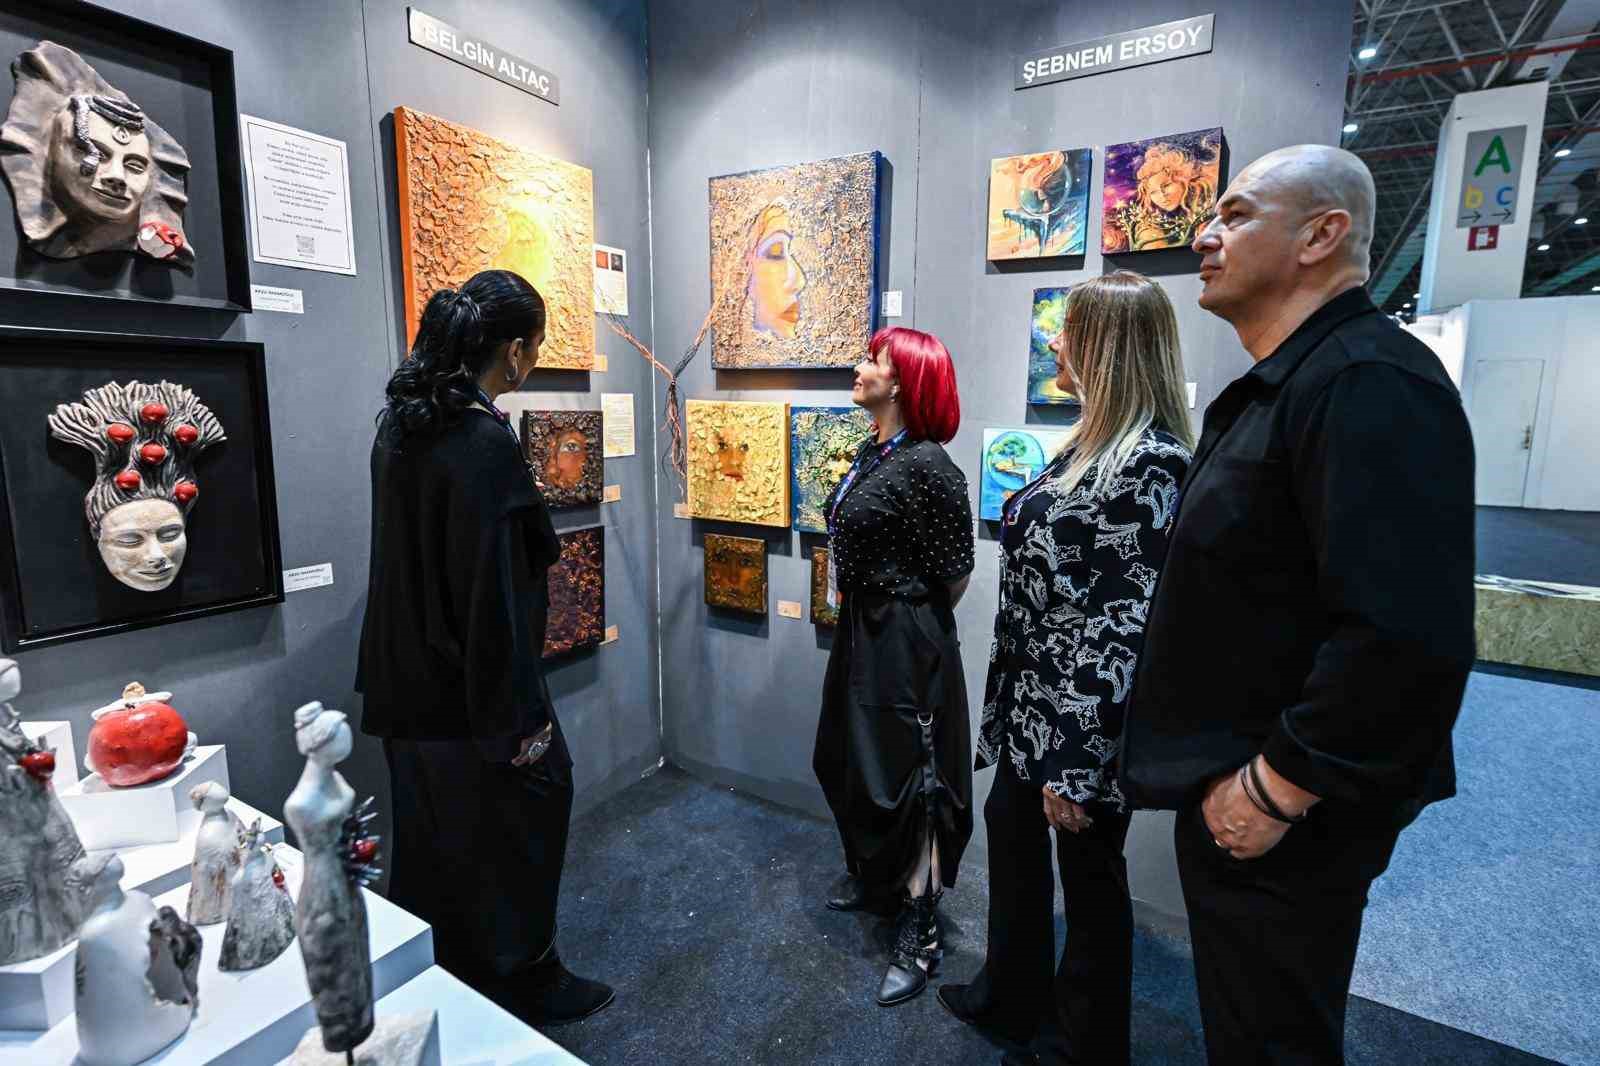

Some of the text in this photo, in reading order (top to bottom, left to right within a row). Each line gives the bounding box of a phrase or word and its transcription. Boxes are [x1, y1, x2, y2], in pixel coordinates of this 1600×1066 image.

[424, 22, 549, 96] BELGİN ALTAÇ
[1023, 25, 1203, 84] ŞEBNEM ERSOY
[1473, 134, 1511, 177] A
